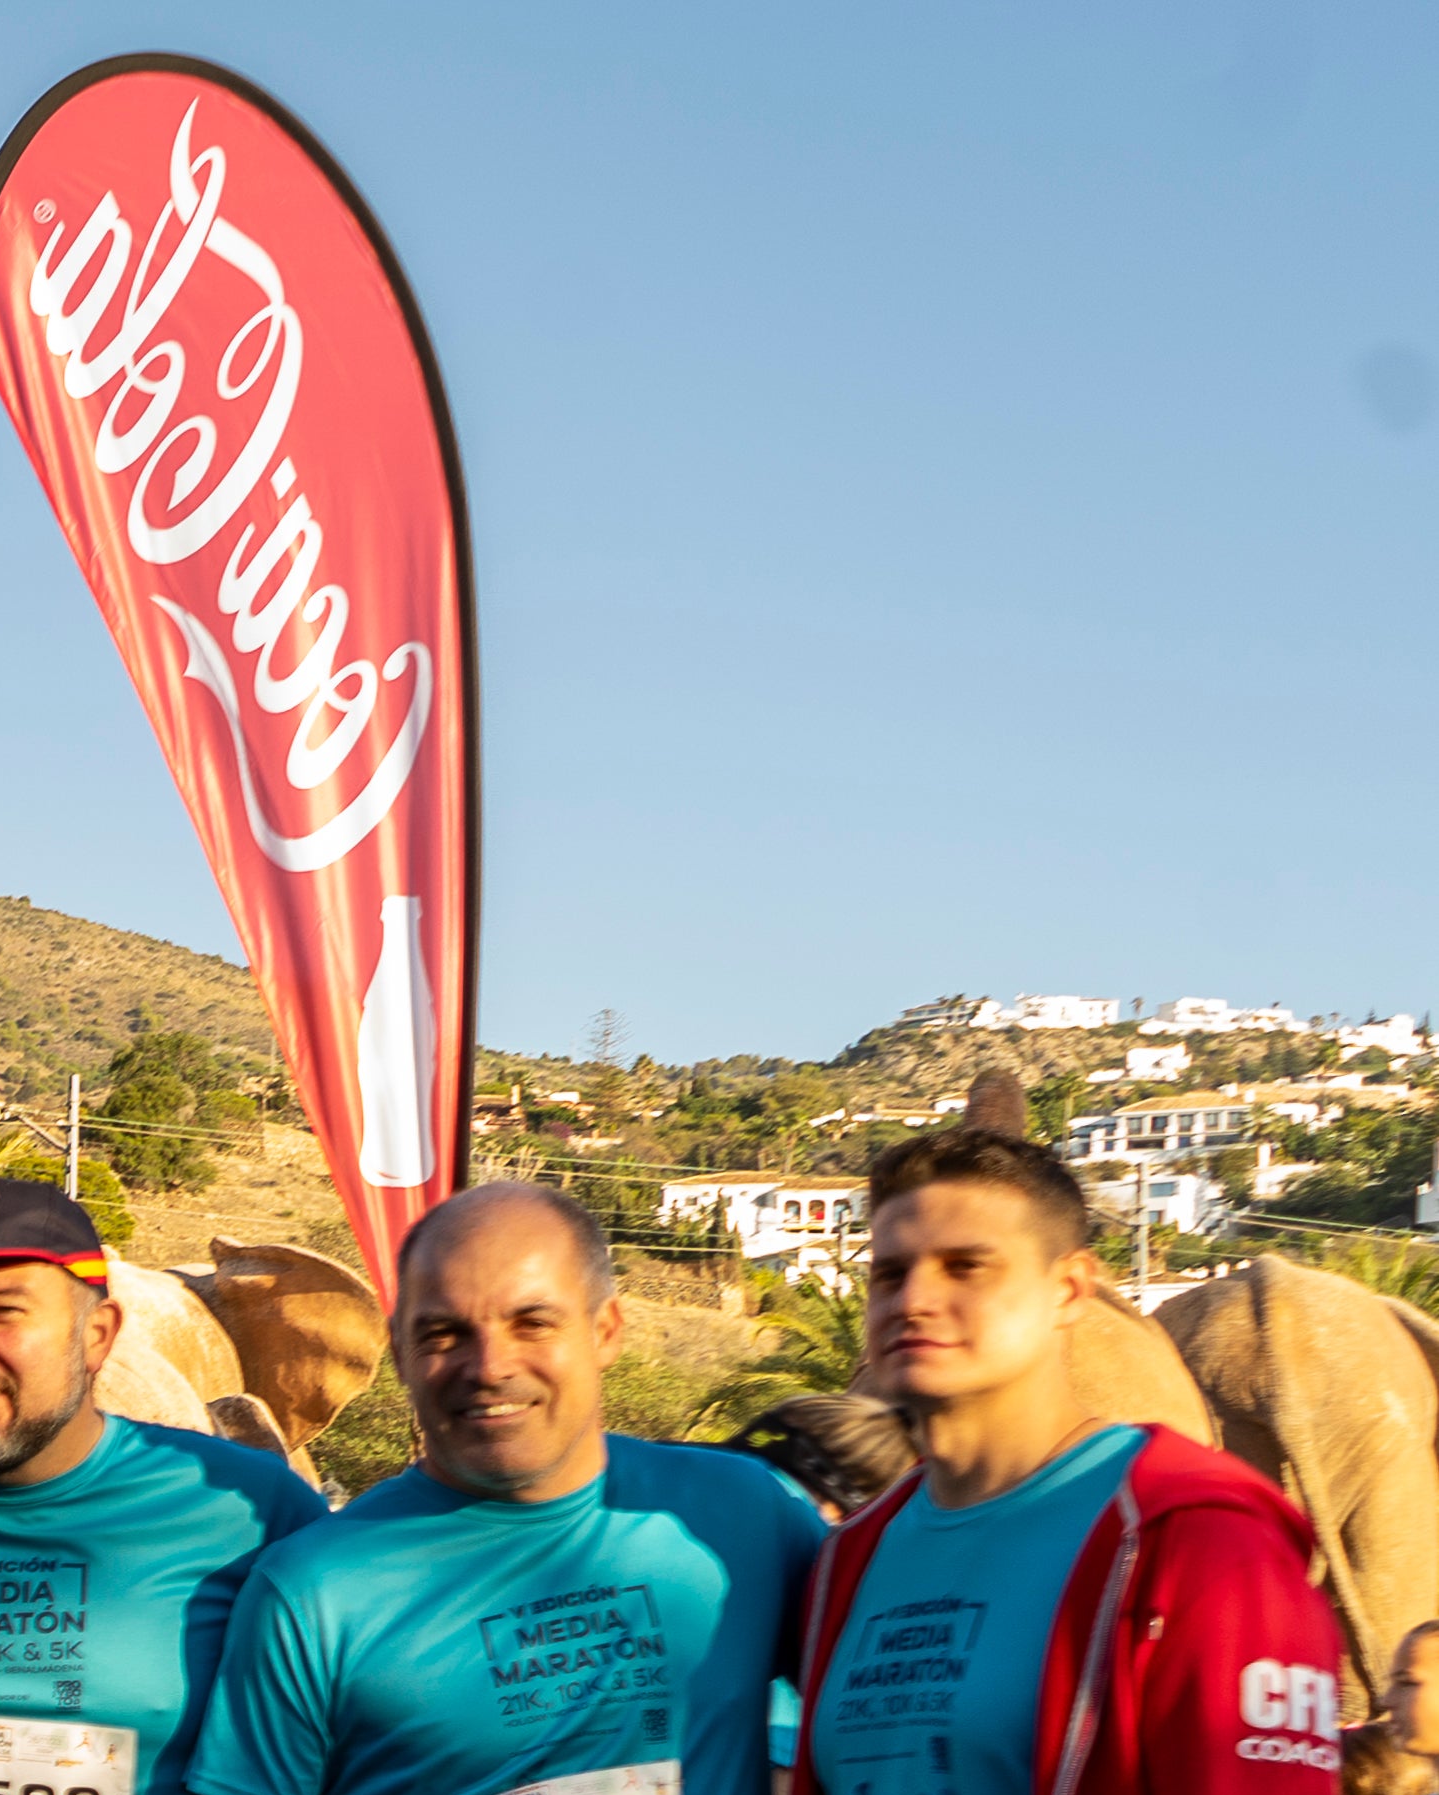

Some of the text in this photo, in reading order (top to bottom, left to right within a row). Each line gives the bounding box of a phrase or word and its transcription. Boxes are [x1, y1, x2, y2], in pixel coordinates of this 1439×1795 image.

[508, 1584, 617, 1618] V EDICIÓN
[515, 1609, 627, 1649] MEDIA
[875, 1623, 955, 1655] MEDIA
[23, 1642, 42, 1662] &
[50, 1640, 84, 1661] 5K
[490, 1629, 666, 1689] MARATÓN
[843, 1649, 971, 1692] MARATÓN
[498, 1689, 555, 1716] 21K,
[555, 1676, 605, 1702] 10K
[633, 1665, 668, 1687] 5K
